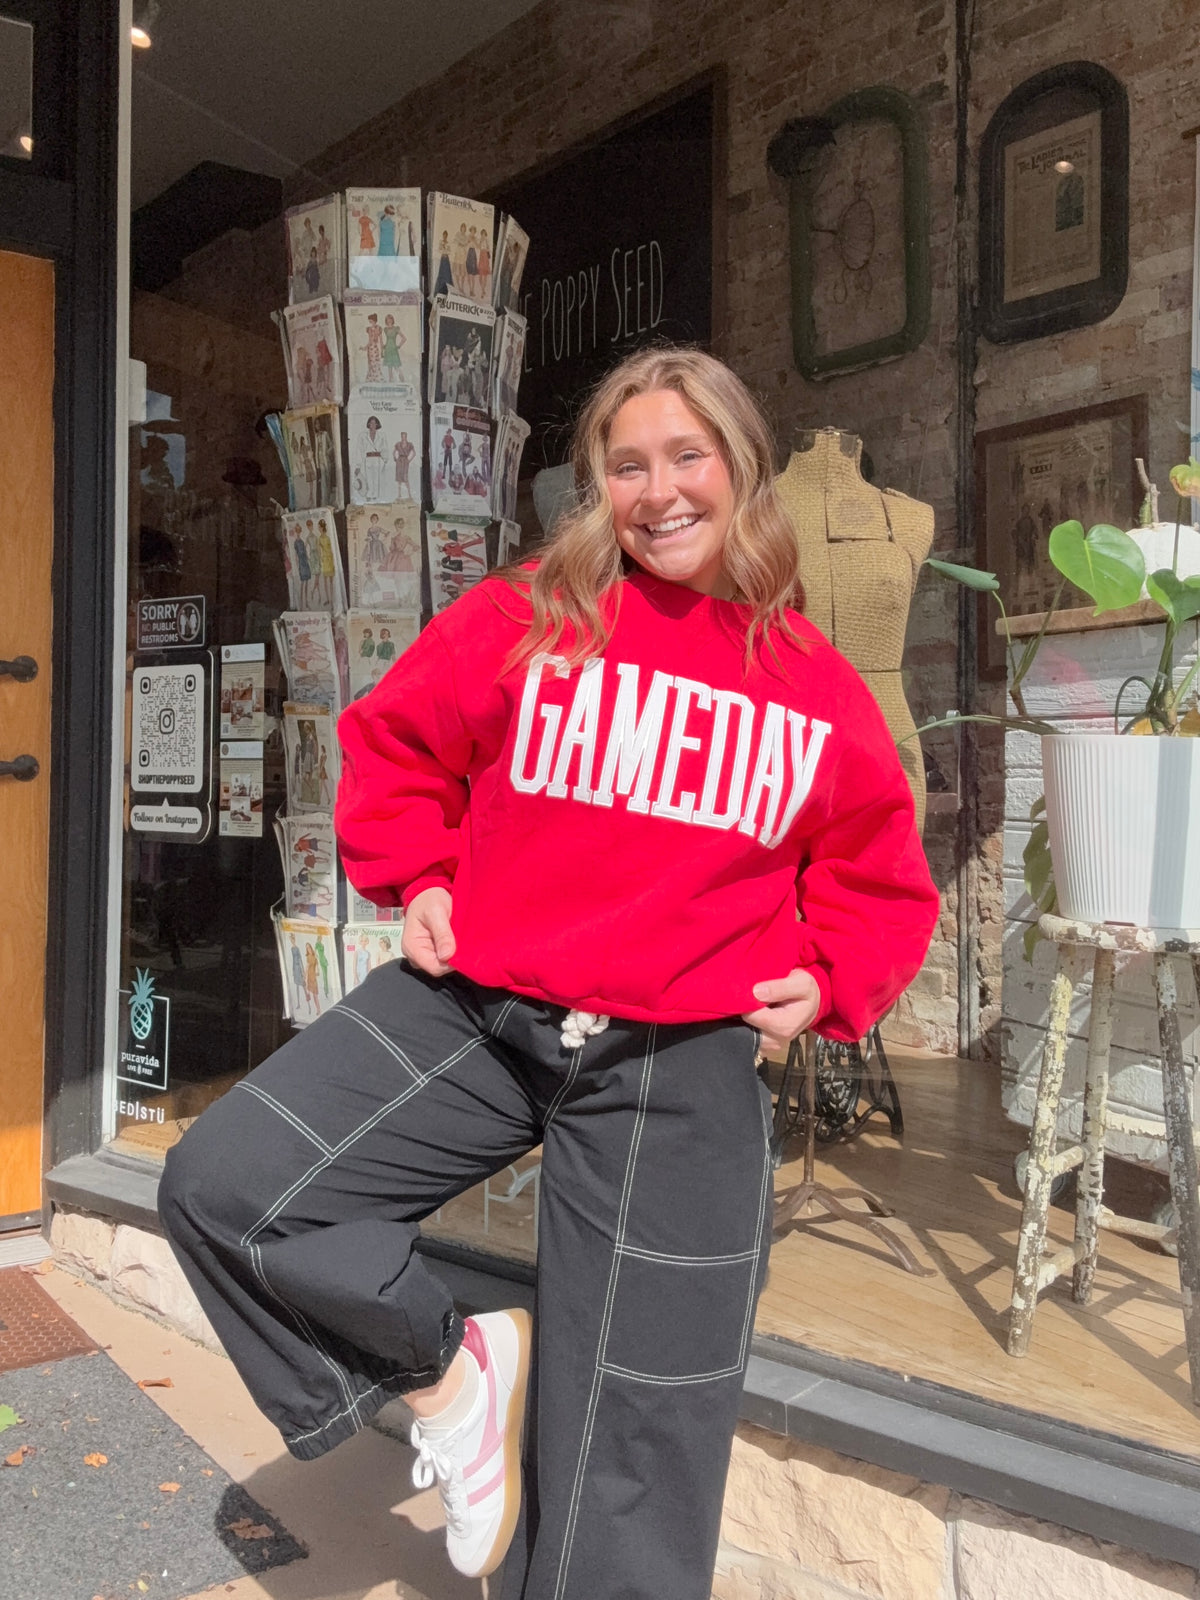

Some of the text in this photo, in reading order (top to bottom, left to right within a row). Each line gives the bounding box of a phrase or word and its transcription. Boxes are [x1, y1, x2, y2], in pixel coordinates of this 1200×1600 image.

[541, 264, 600, 366] POPPY
[610, 240, 664, 342] SEED
[142, 604, 179, 620] SORRY
[141, 622, 176, 632] NO PUBLIC
[141, 633, 179, 643] RESTROOMS
[509, 651, 832, 850] GAMEDAY
[138, 775, 195, 785] SHOPTHEPOPPYSEED
[133, 812, 198, 828] Follow on Instagram
[121, 1052, 160, 1068] puravida
